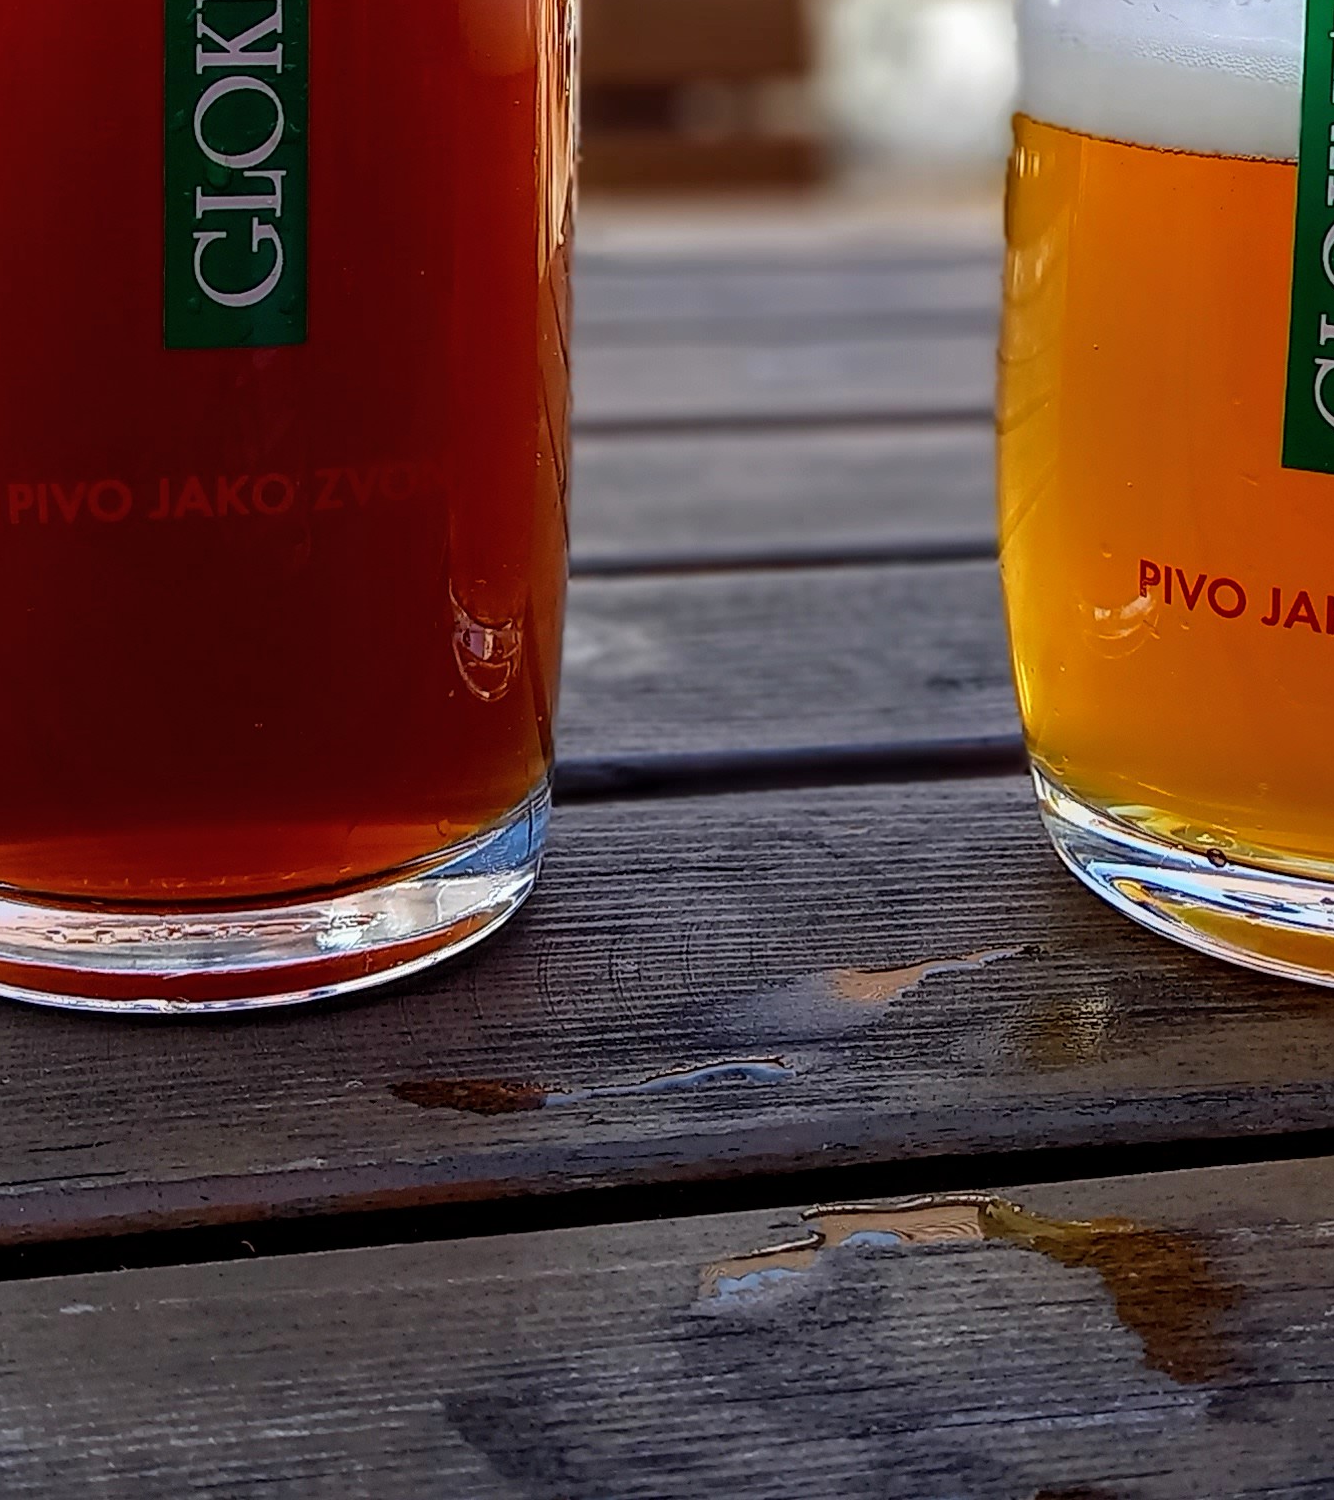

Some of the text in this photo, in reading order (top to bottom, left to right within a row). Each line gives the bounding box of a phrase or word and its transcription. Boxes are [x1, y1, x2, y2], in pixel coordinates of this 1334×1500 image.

[7, 481, 132, 524] PIVO
[148, 474, 295, 518] JAKO
[1138, 558, 1248, 620] PIVO
